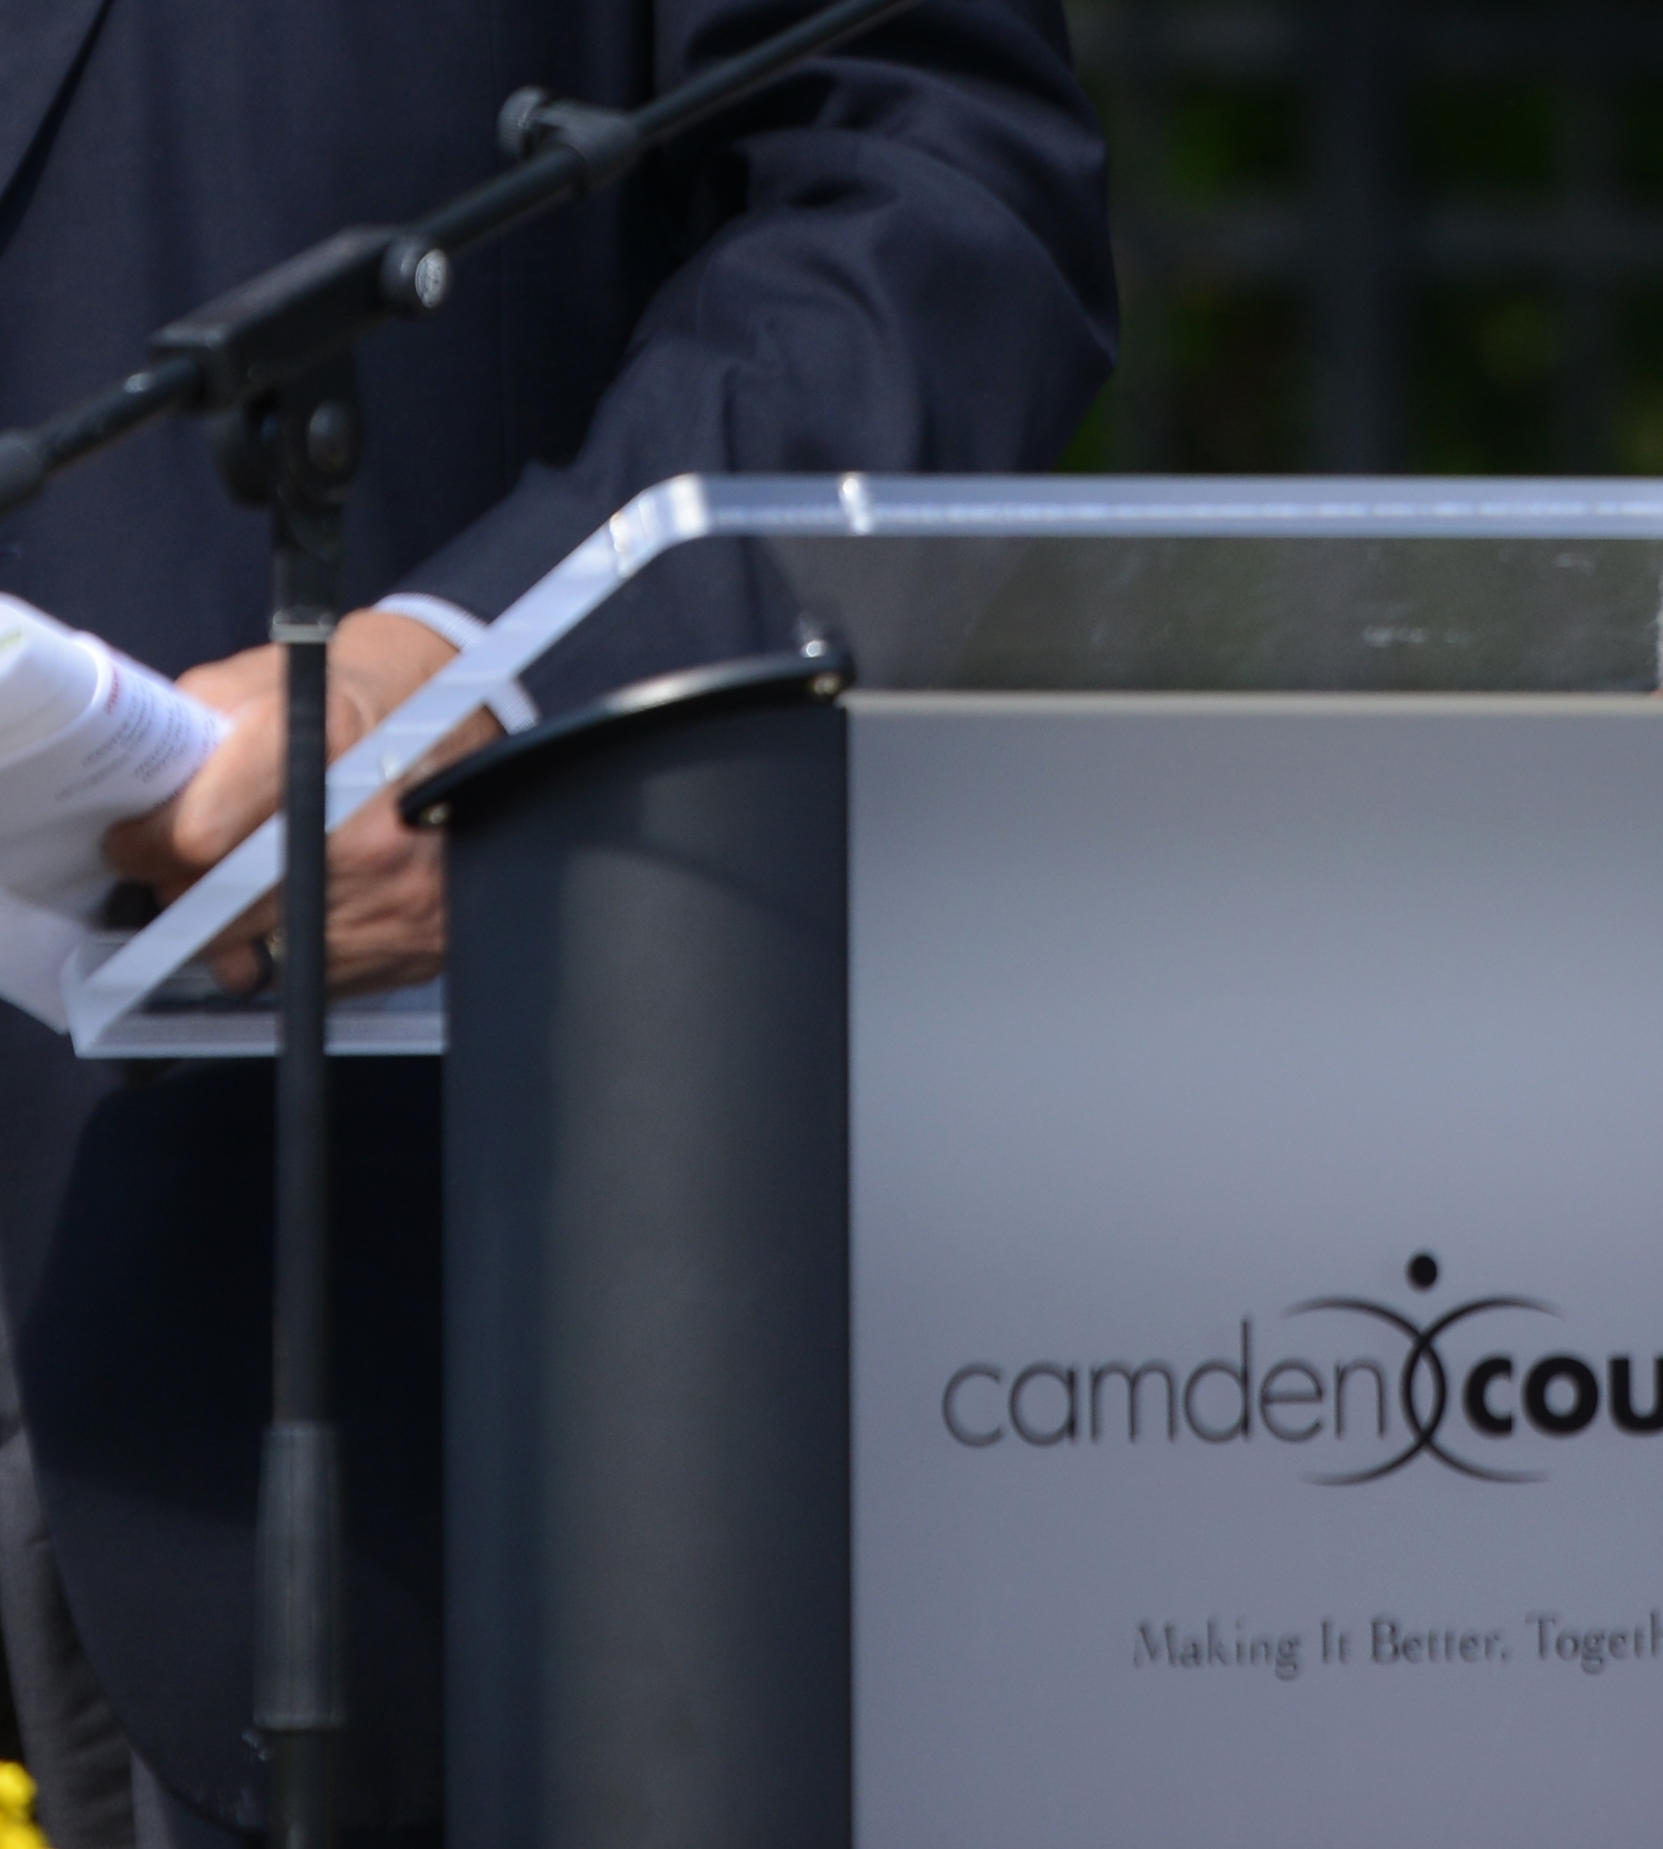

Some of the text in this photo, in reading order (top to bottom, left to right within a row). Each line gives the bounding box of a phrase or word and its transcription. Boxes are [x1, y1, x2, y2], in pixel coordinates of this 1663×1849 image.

[941, 1316, 1388, 1449] camden
[1134, 1615, 1302, 1681] Making
[1319, 1615, 1350, 1664] It
[1368, 1614, 1509, 1664] Better.
